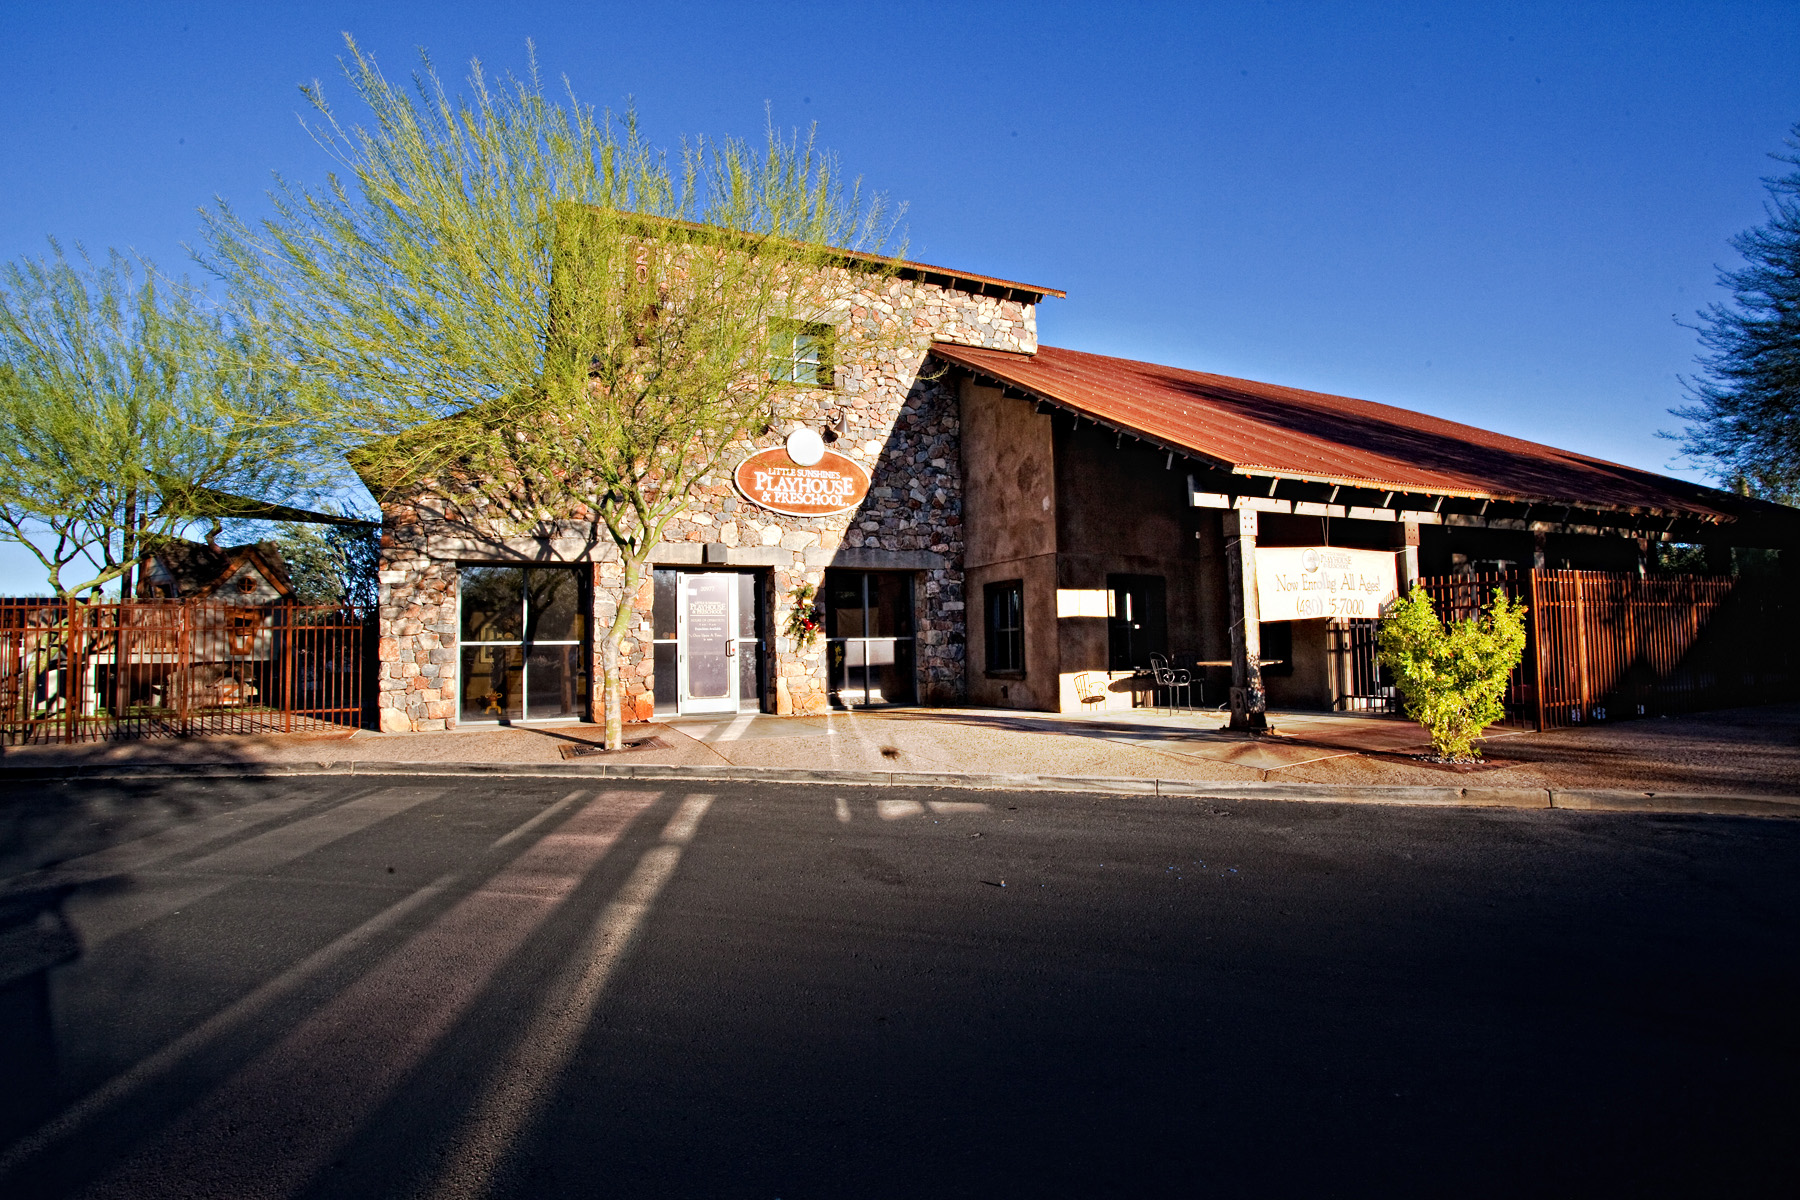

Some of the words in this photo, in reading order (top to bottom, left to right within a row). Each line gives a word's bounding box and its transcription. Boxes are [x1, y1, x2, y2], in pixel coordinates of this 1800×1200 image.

[768, 467, 796, 477] LITTLE
[754, 471, 855, 496] PLAYHOUSE
[761, 491, 771, 503] &
[1275, 573, 1299, 592] Now
[1340, 572, 1355, 591] All
[1358, 573, 1380, 595] Ages!
[690, 603, 726, 611] PLAYHOUSE
[1296, 595, 1323, 617] (480)
[1329, 597, 1364, 615] 5-7000
